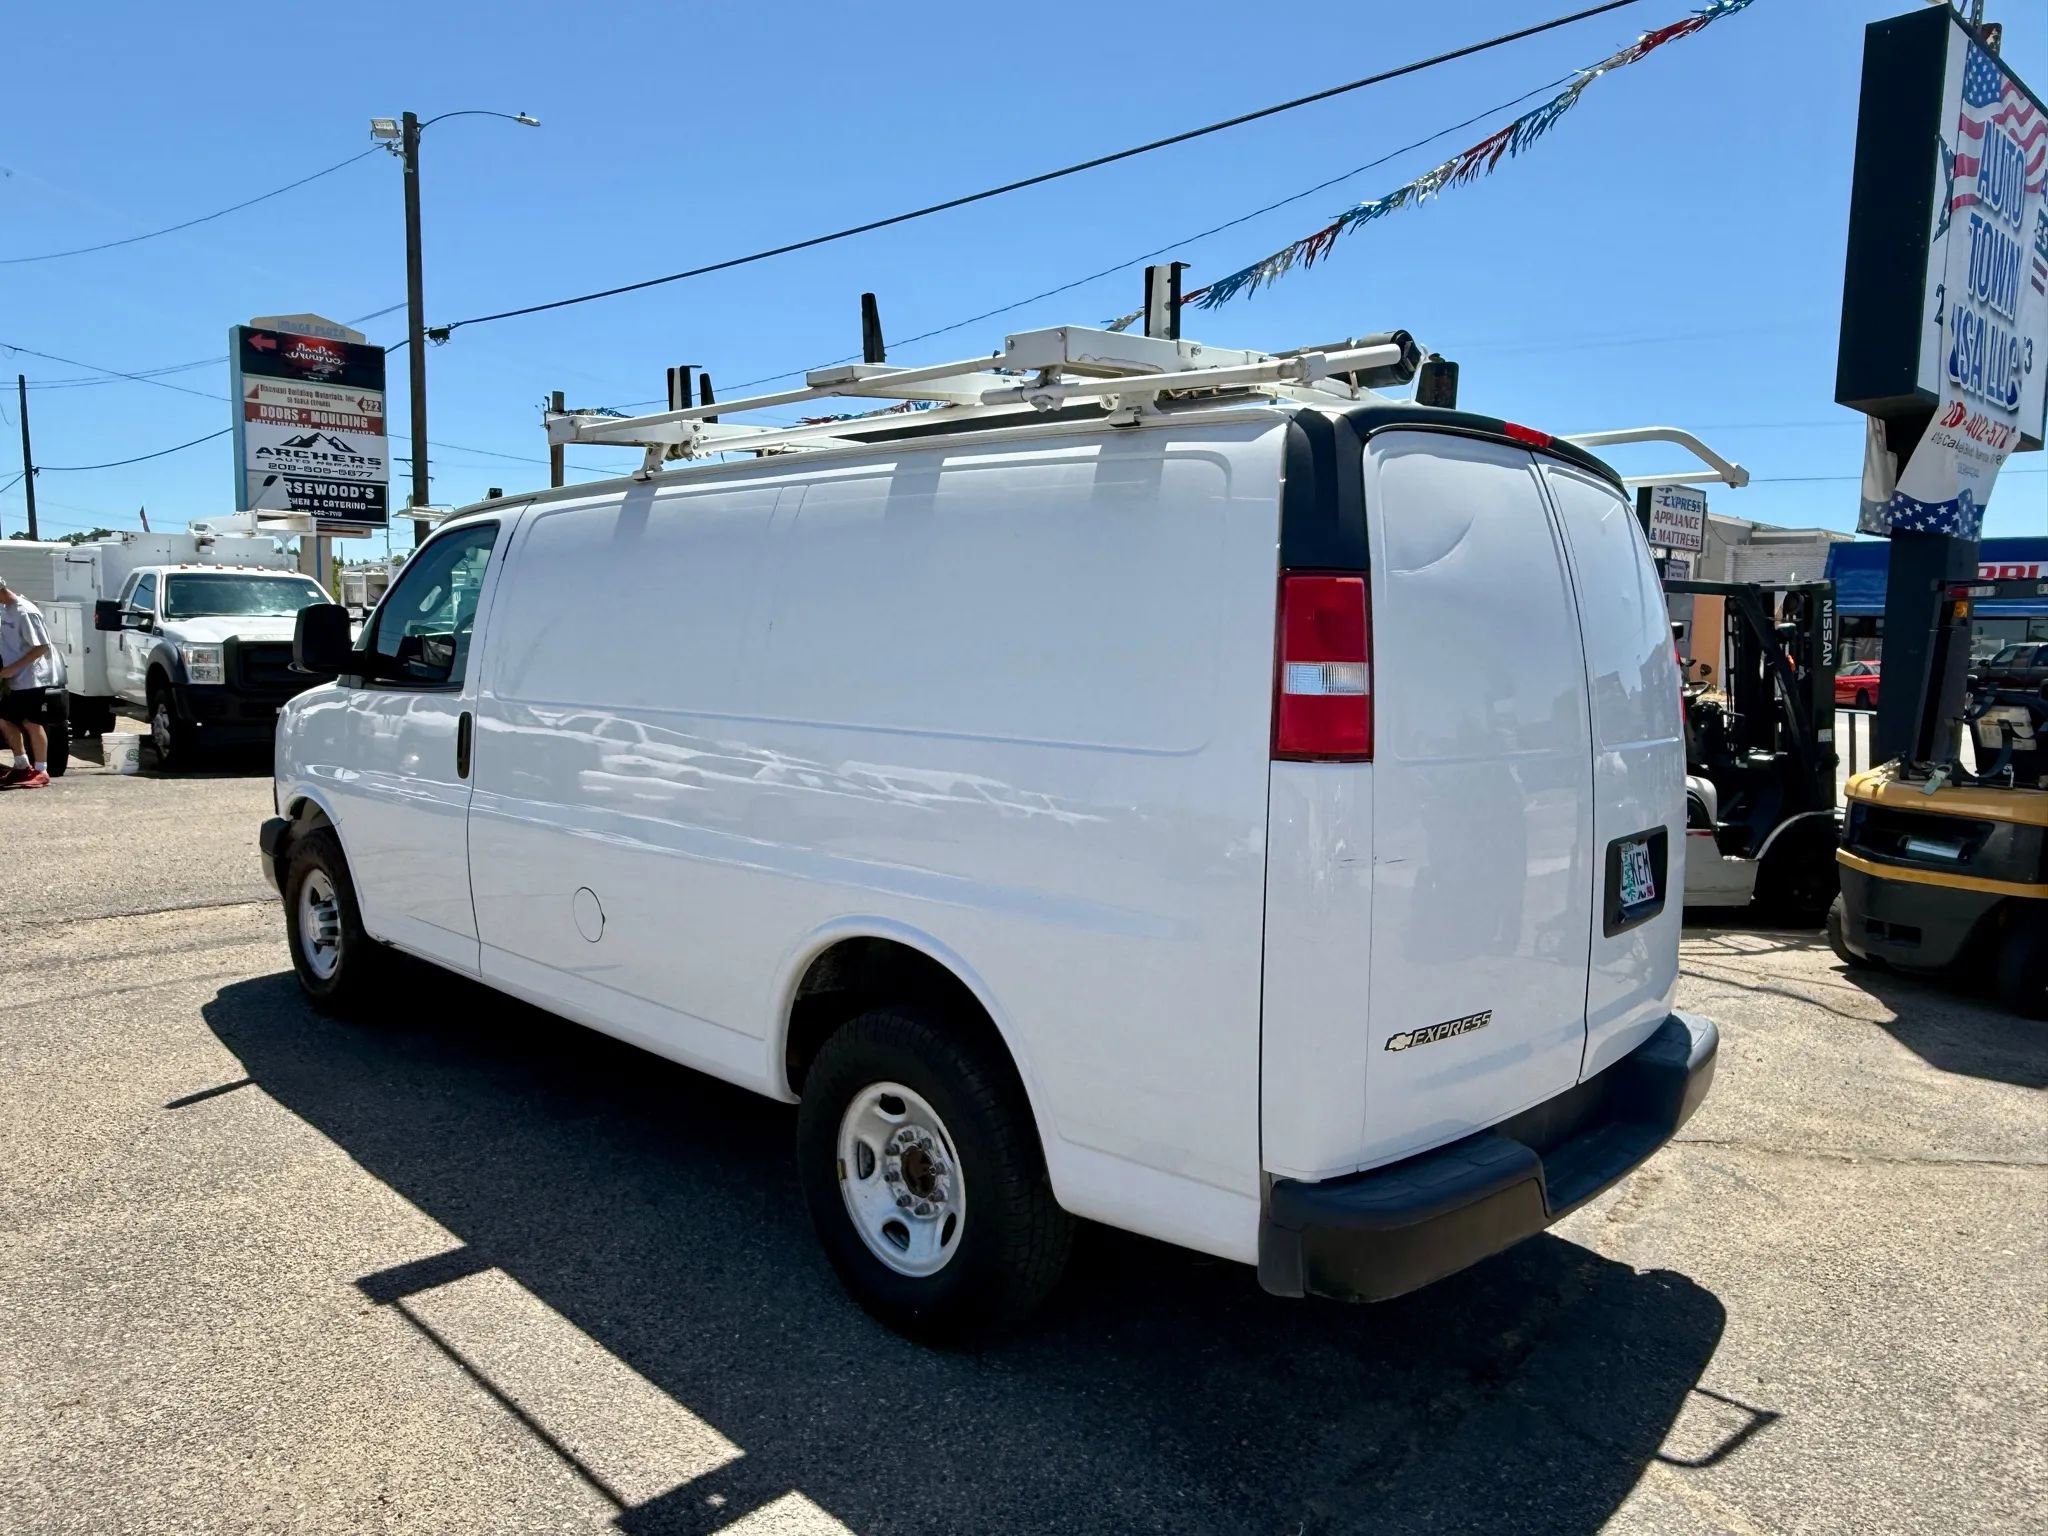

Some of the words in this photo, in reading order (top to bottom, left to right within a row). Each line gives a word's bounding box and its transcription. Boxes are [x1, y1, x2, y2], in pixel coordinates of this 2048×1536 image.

[1977, 118, 2025, 229] AUTO
[1969, 211, 2022, 320] TOWN
[288, 388, 314, 399] Building
[361, 400, 380, 412] 422
[260, 405, 299, 421] DOORS
[310, 411, 368, 428] MOULDING
[256, 447, 382, 466] ARCHERS
[275, 457, 310, 465] AUTO
[323, 500, 366, 510] CATERING
[1658, 496, 1702, 513] EXPRESS
[1654, 510, 1700, 530] APPLIANCE
[1658, 529, 1701, 547] MATTRESS
[1823, 600, 1833, 666] NISSAN
[1411, 1012, 1492, 1047] EXPRESS
